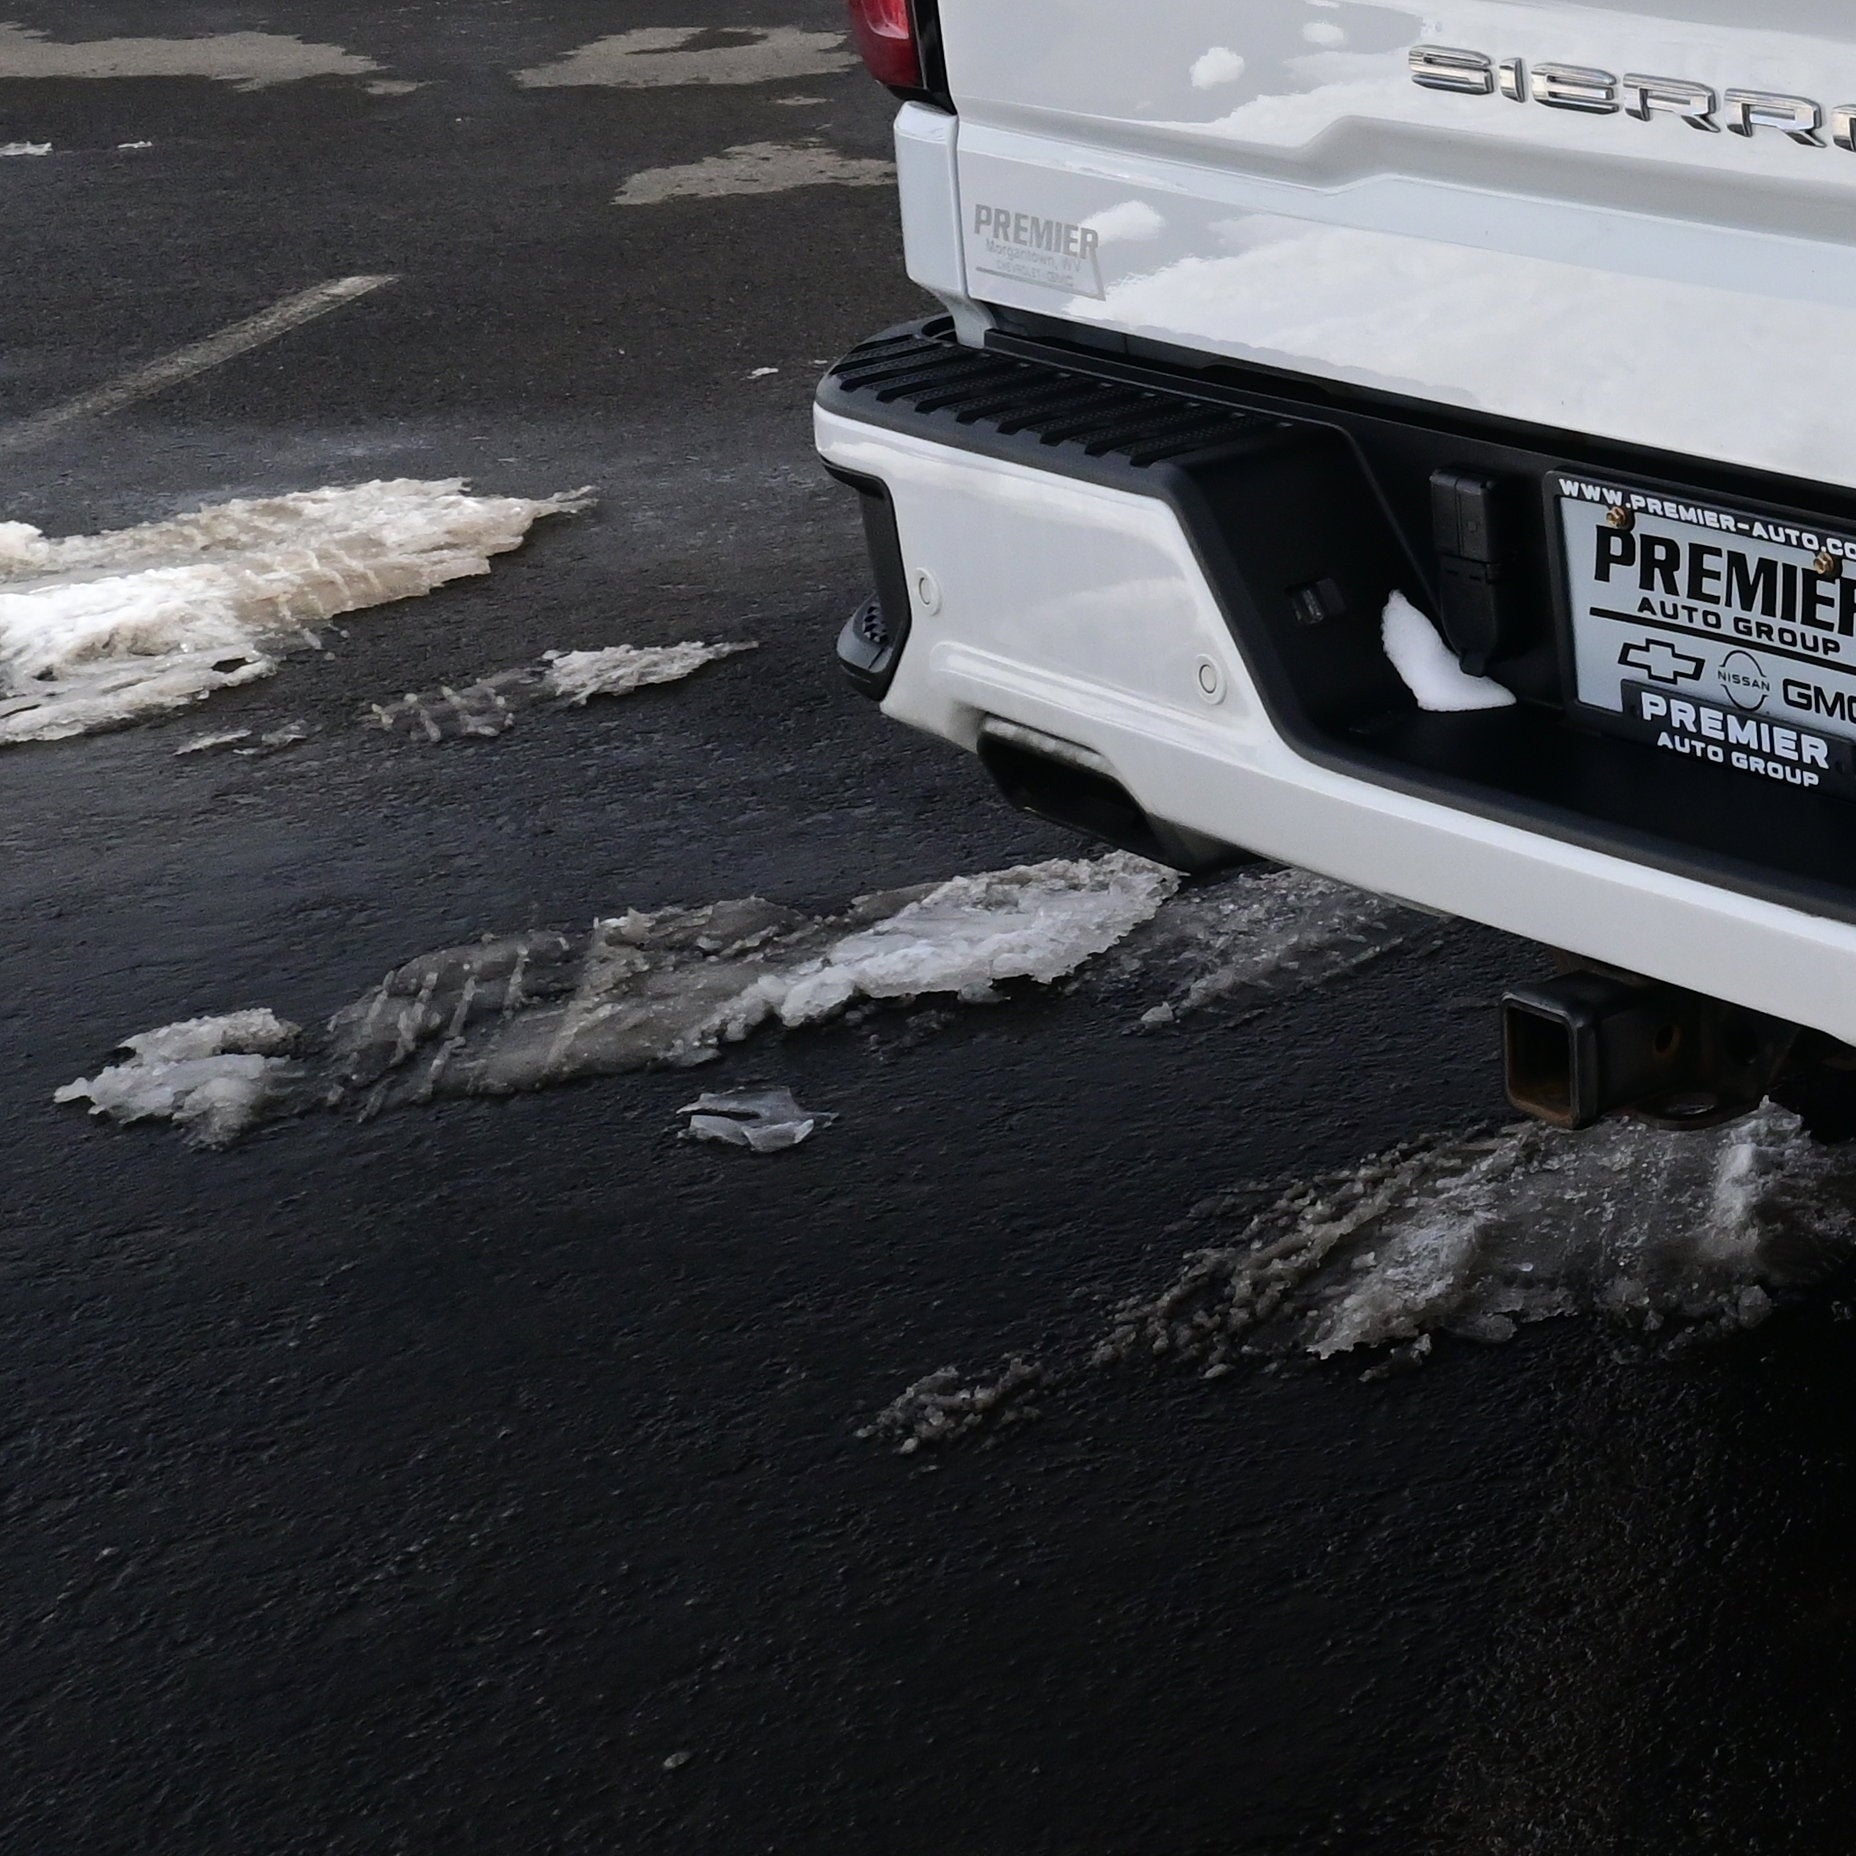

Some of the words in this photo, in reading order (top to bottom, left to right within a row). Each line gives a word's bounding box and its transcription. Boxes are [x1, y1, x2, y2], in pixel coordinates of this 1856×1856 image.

[974, 204, 1099, 259] PREMIER
[1637, 596, 1722, 629] AUTO
[1733, 616, 1841, 656] GROUP
[1717, 670, 1771, 692] NISSAN
[1640, 691, 1829, 769] PREMIER
[1657, 730, 1724, 763] AUTO
[1731, 751, 1820, 787] GROUP
